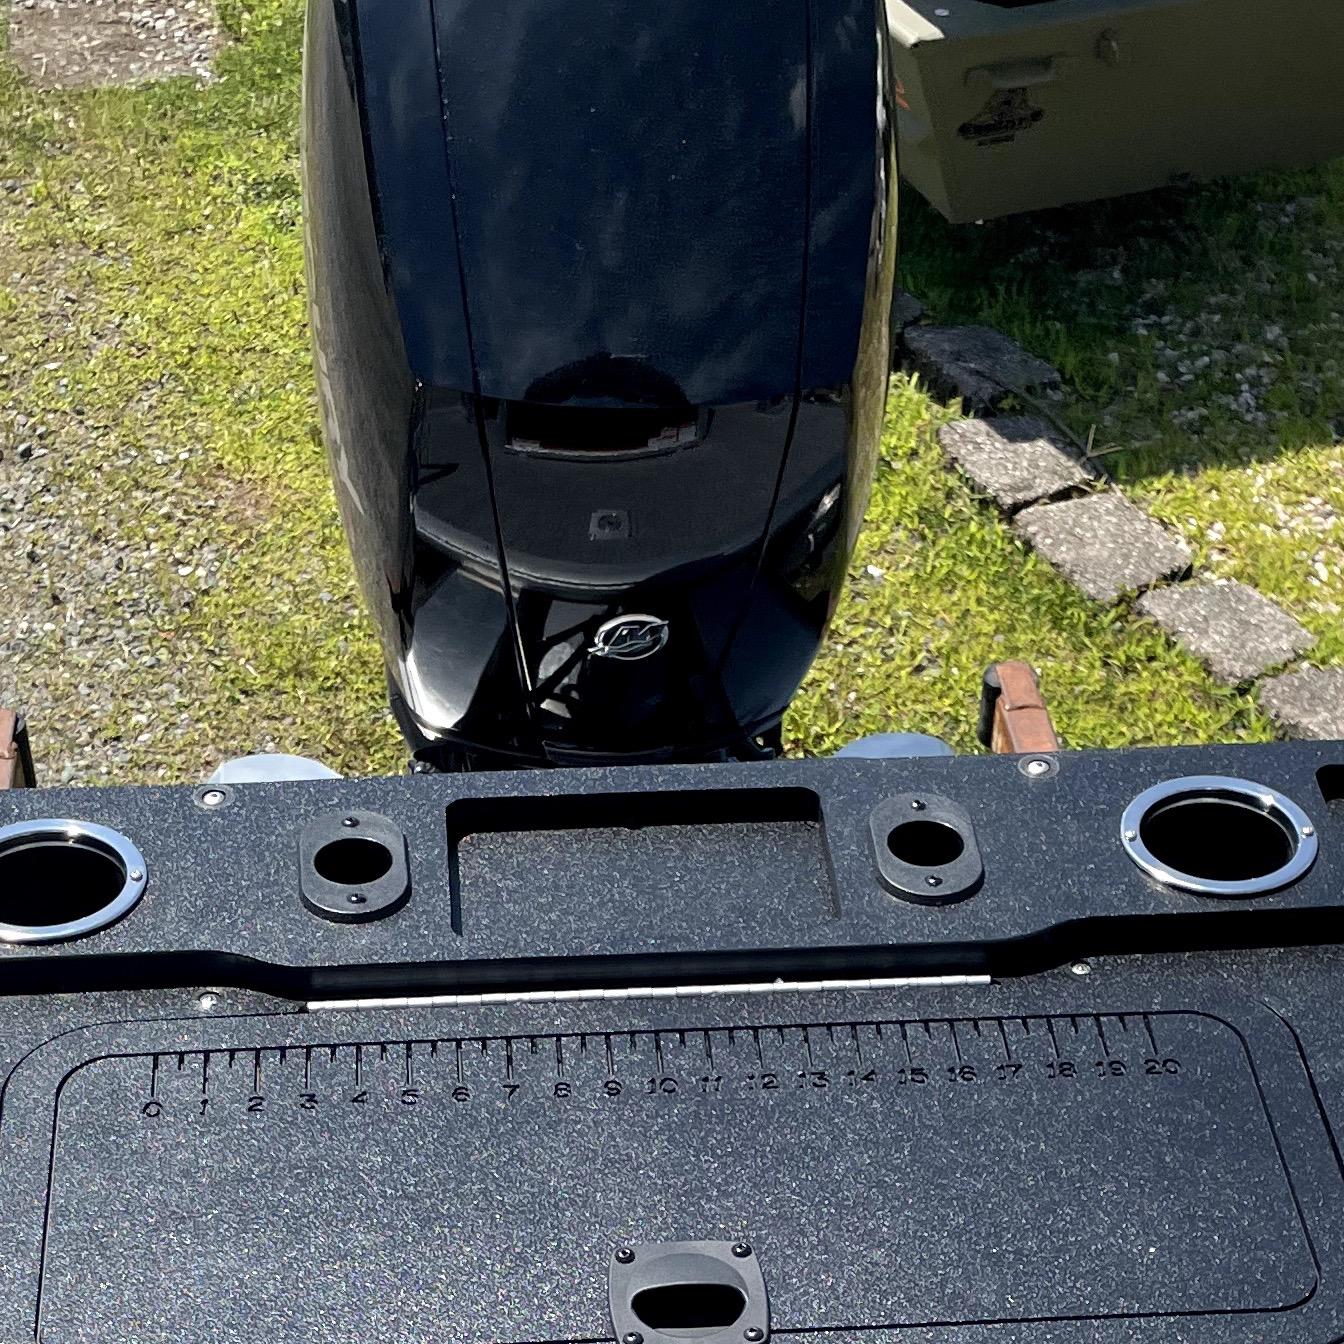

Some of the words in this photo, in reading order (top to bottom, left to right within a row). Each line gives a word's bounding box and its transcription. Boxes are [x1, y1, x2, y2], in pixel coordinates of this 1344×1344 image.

[142, 1101, 163, 1117] 0
[199, 1098, 209, 1115] 1
[247, 1095, 265, 1112] 2
[299, 1093, 318, 1109] 3
[352, 1090, 367, 1105] 4
[401, 1088, 419, 1105] 5
[452, 1086, 471, 1101] 6
[502, 1083, 520, 1099] 7
[553, 1081, 571, 1098] 8
[604, 1079, 622, 1096] 9
[646, 1077, 679, 1094] 10
[701, 1075, 722, 1092] 11
[747, 1073, 779, 1090] 12
[797, 1071, 830, 1089] 13
[847, 1068, 878, 1087] 14
[897, 1066, 929, 1084] 15
[947, 1065, 977, 1083] 16
[995, 1063, 1023, 1081] 17
[1046, 1061, 1078, 1079] 18
[1095, 1059, 1127, 1077] 19
[1143, 1057, 1182, 1075] 20
